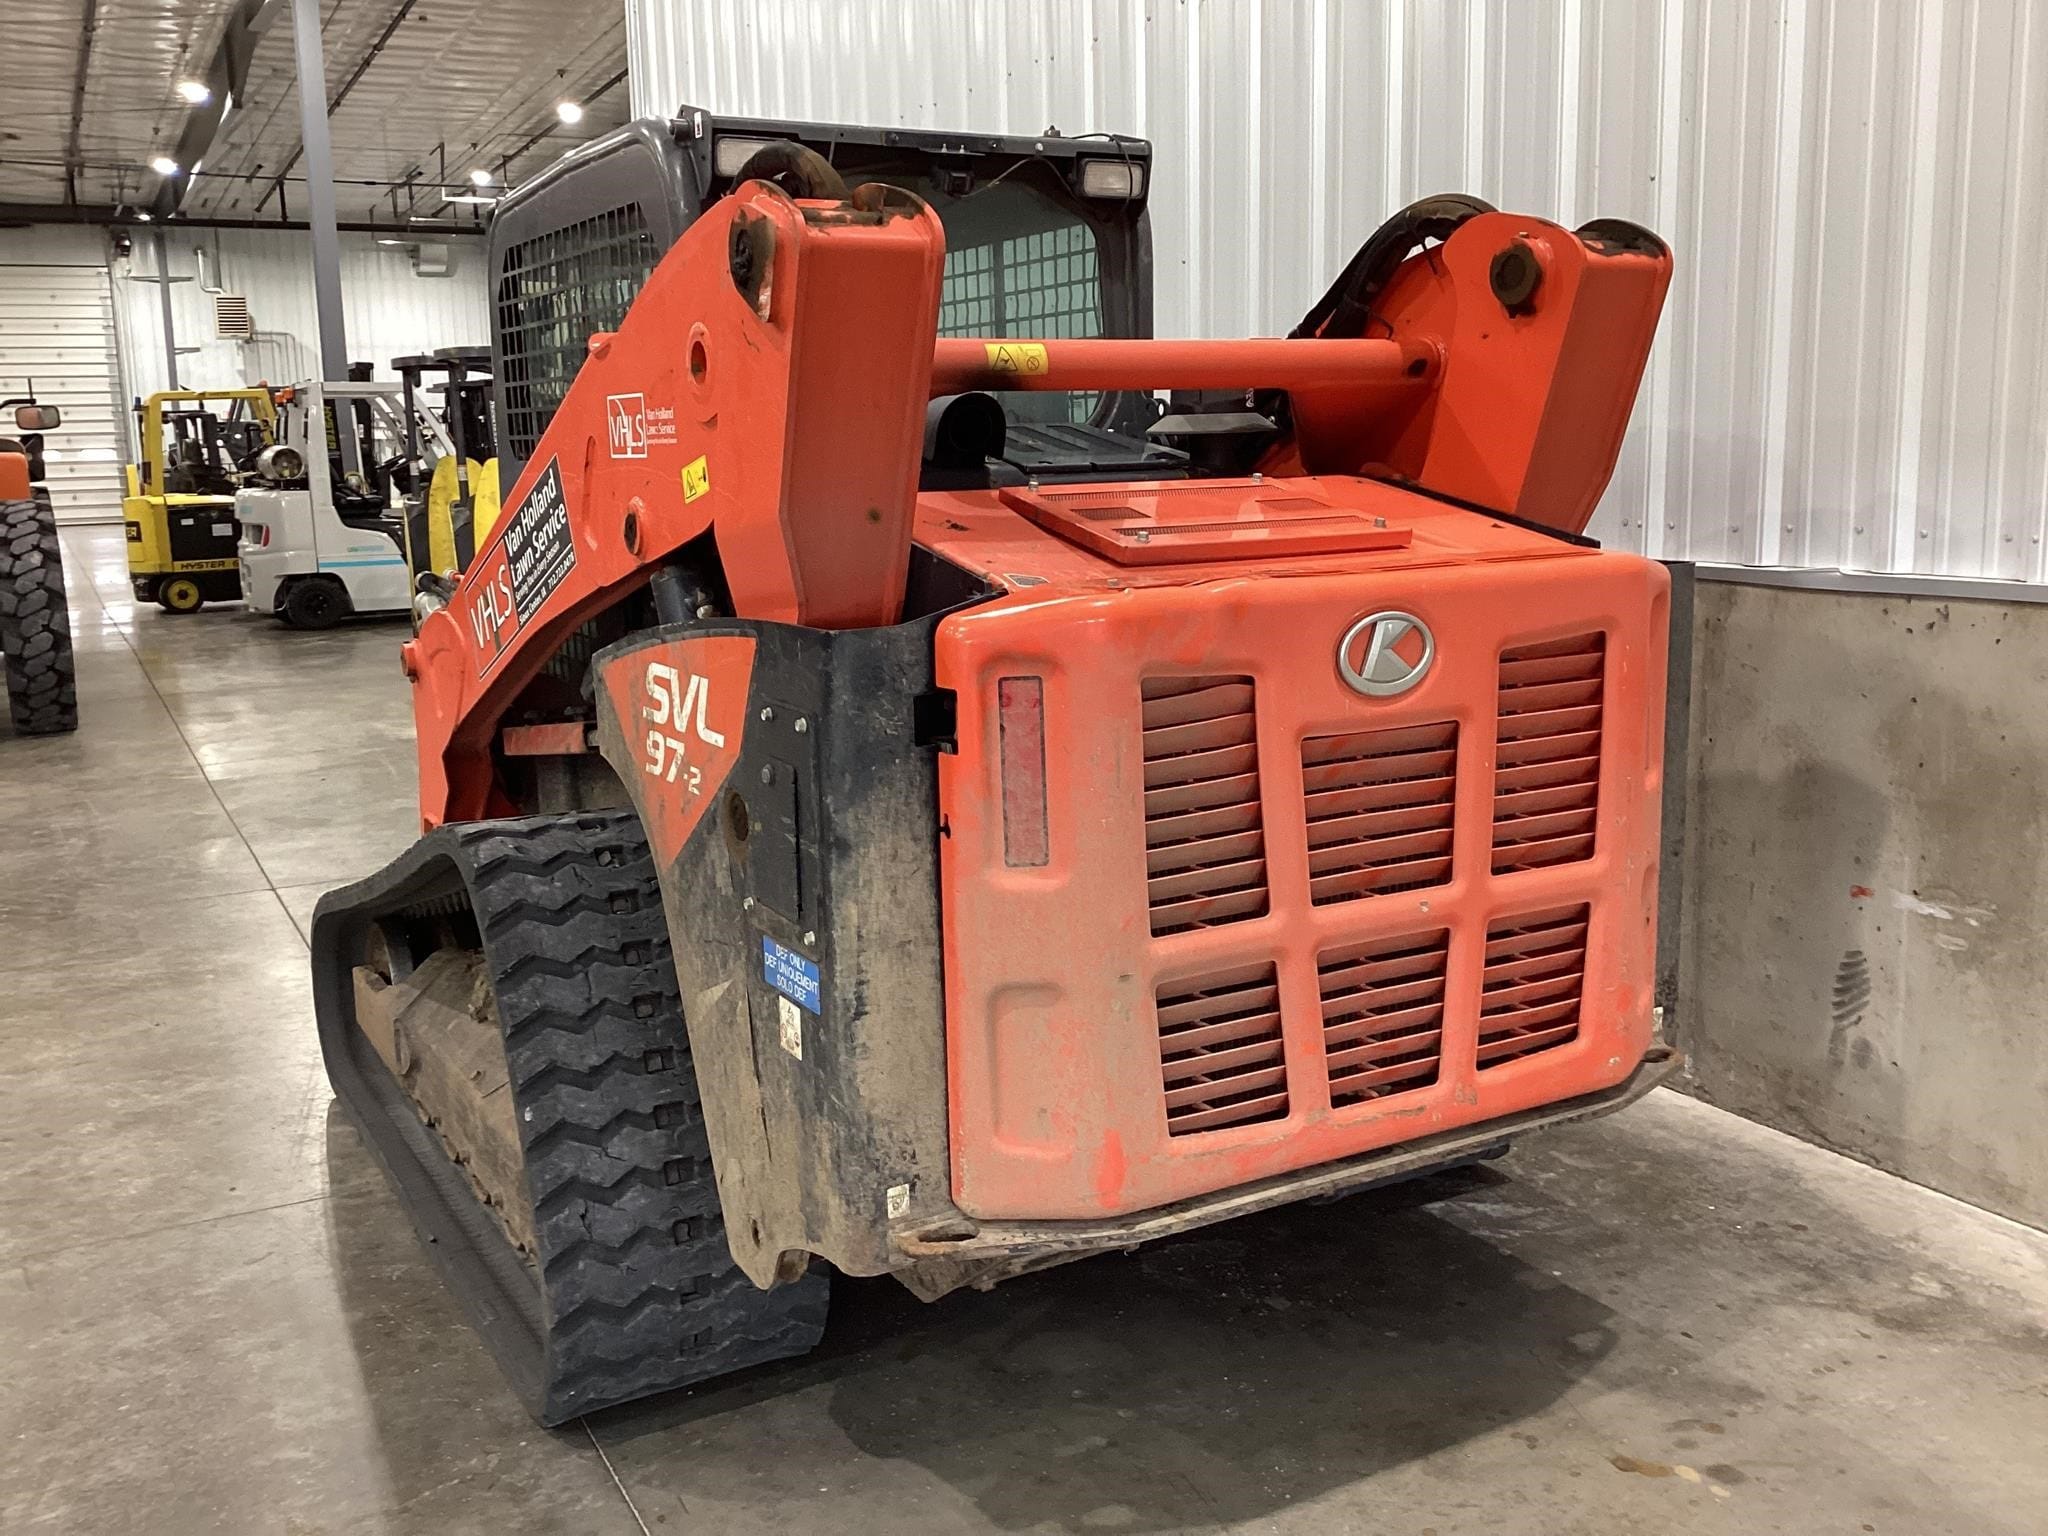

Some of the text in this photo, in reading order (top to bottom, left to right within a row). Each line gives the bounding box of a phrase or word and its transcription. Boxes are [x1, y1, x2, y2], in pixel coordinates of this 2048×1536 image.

[610, 414, 644, 447] VHLS
[658, 422, 676, 435] Service
[504, 467, 557, 557] Van Holland
[510, 503, 567, 588] Lawn Service
[181, 560, 226, 570] HYSTER
[470, 563, 512, 649] VHLS
[643, 662, 725, 748] SVL
[765, 952, 819, 996] DEF UNIQUEMENT
[775, 944, 806, 971] DEF ONLY
[777, 974, 807, 1002] SOLO DEF
